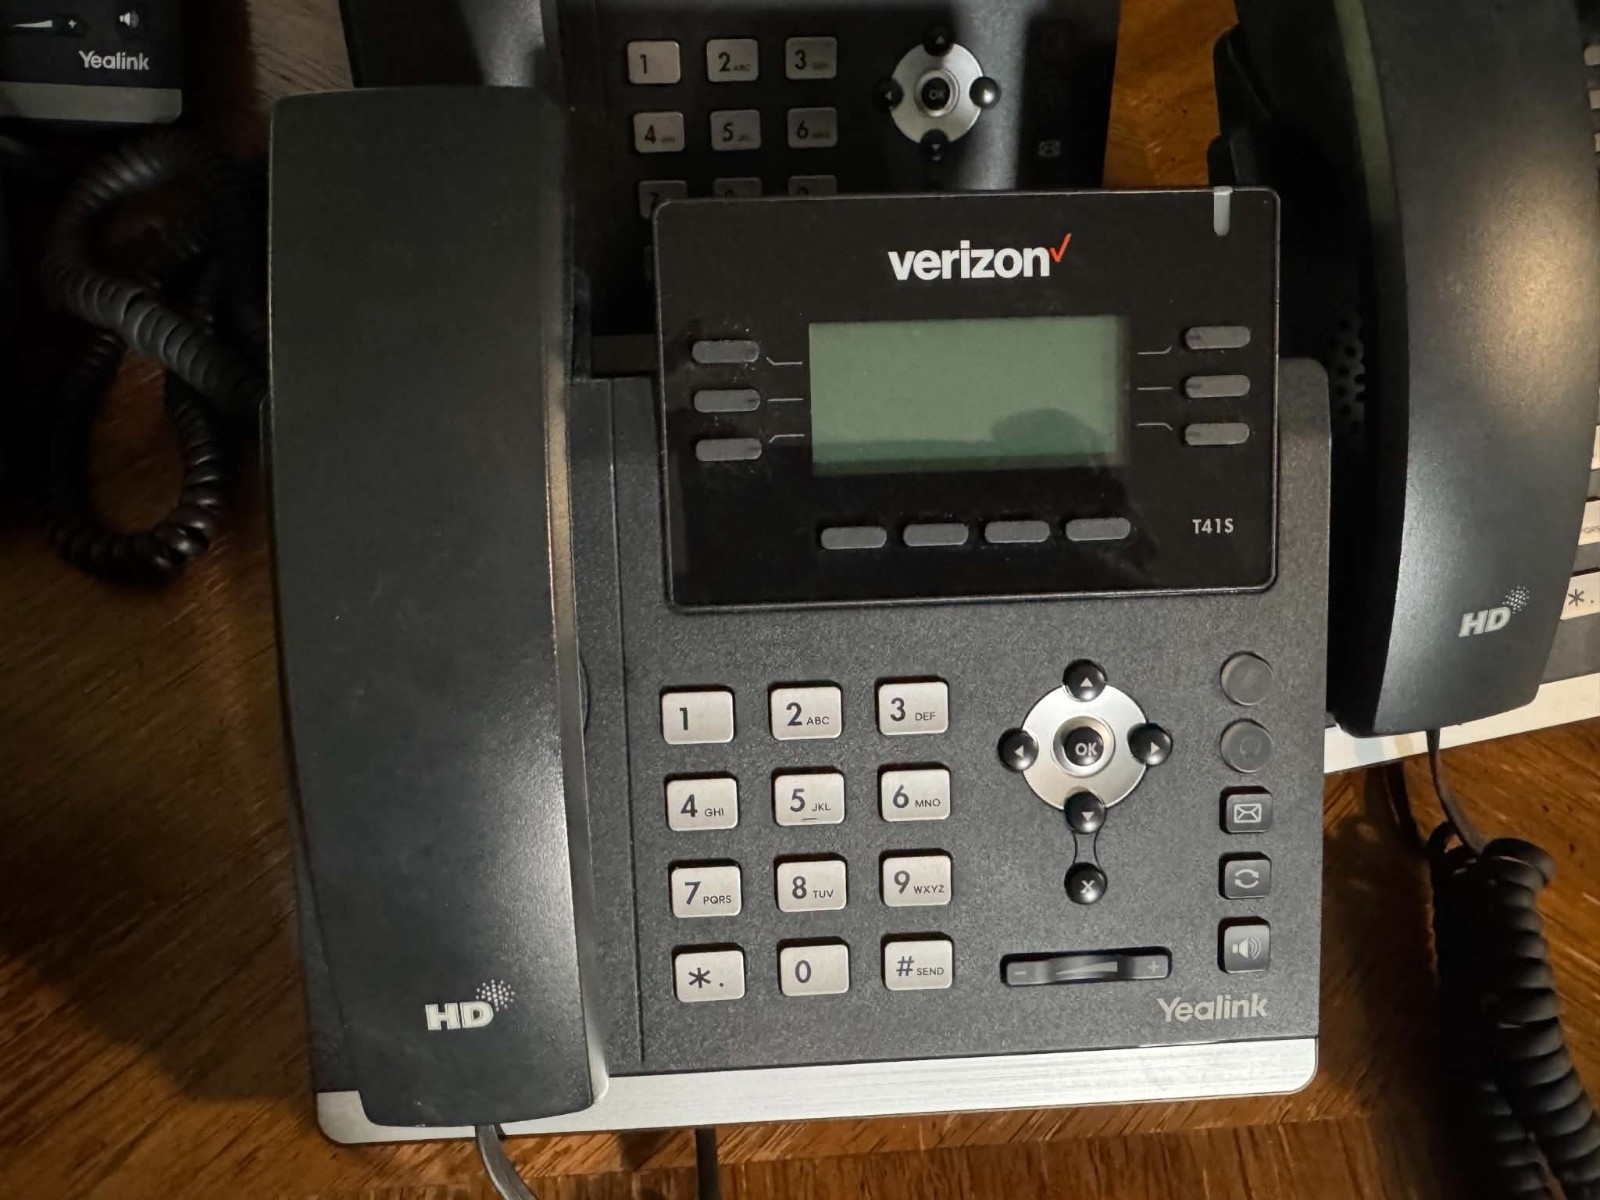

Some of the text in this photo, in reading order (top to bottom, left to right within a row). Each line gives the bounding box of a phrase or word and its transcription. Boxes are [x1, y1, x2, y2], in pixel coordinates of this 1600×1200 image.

[78, 50, 150, 70] Yealink
[639, 53, 649, 75] 1
[718, 51, 731, 72] 2
[794, 49, 807, 70] 3
[644, 124, 657, 144] 4
[722, 122, 734, 142] 5
[796, 120, 809, 140] 6
[887, 239, 1051, 281] verizon
[1192, 517, 1234, 535] T41S
[1458, 606, 1512, 638] HD
[679, 707, 689, 731] 1
[786, 702, 831, 727] 2 ABC
[890, 697, 936, 722] 3 DEF
[1074, 742, 1098, 757] OK
[680, 794, 724, 818] 4 GHI
[790, 788, 831, 813] 5 JKL
[892, 784, 941, 809] 6 MNO
[684, 881, 732, 905] 7 PQRS
[791, 876, 834, 900] 8 TUV
[893, 870, 945, 895] 9 WXYZ
[794, 959, 812, 984] 0
[916, 967, 945, 977] SEND
[424, 1000, 495, 1031] HD
[1156, 993, 1269, 1022] Yealink
